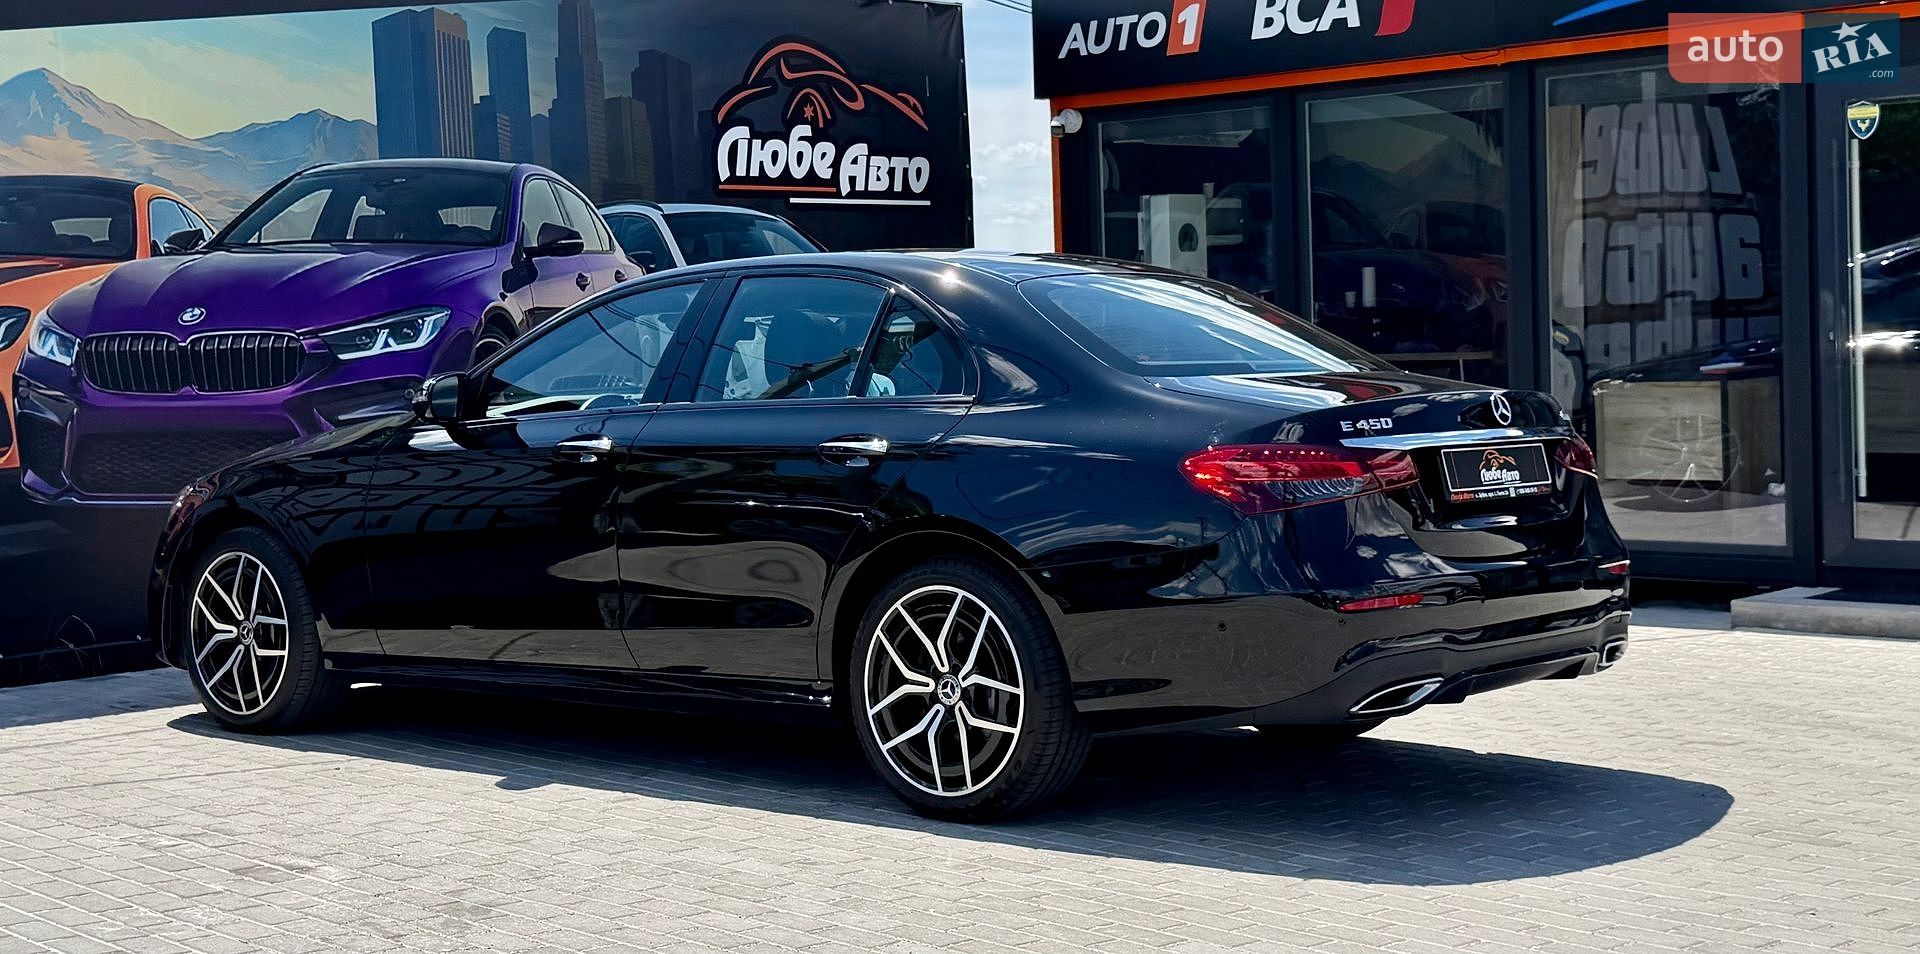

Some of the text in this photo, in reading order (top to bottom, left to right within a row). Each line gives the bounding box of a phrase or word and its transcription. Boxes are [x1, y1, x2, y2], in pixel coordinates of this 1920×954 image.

[1251, 0, 1361, 40] BCA
[717, 124, 930, 197] Любе Авто
[1339, 417, 1393, 432] E 450
